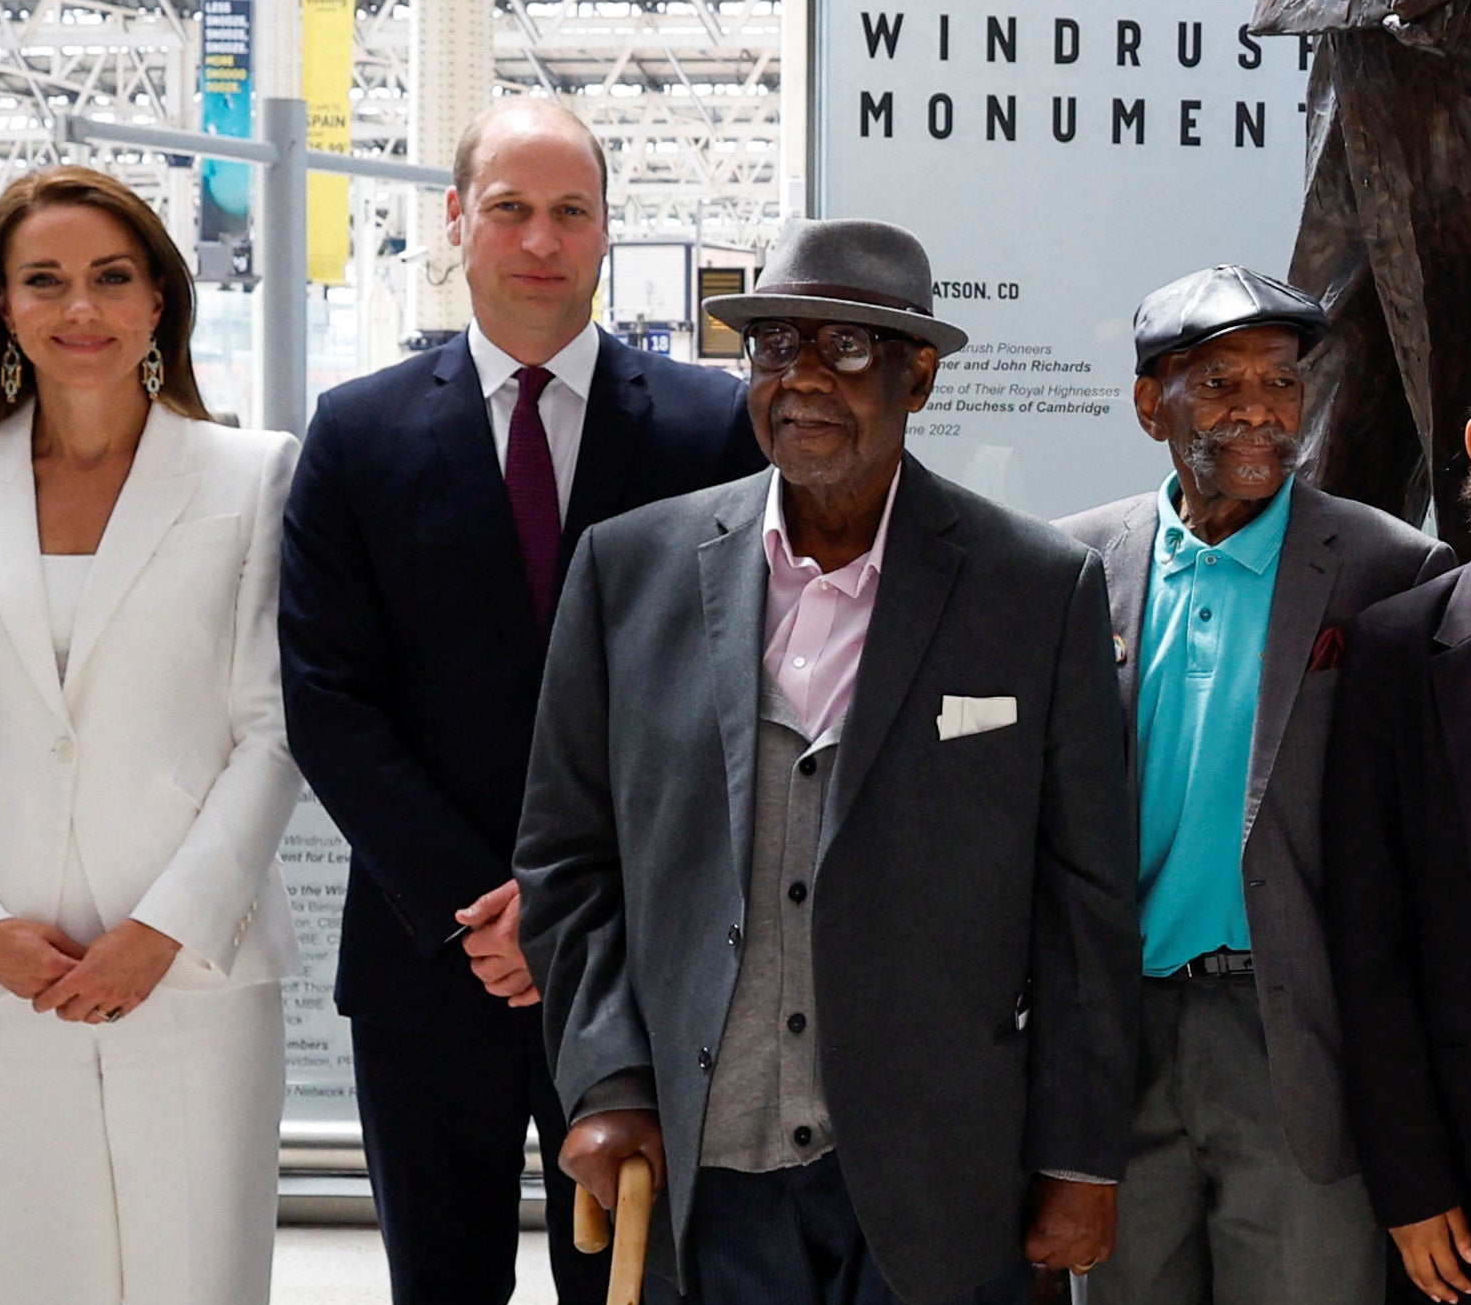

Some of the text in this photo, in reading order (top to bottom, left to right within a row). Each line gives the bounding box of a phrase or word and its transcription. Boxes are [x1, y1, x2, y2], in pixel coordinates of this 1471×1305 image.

[859, 91, 1307, 148] MONUMEN
[931, 281, 1019, 300] ATSON, CD
[996, 342, 1052, 355] Pioneers
[963, 359, 1091, 373] and John Richards
[958, 383, 1121, 399] of Their Royal Highnesses
[926, 400, 1110, 417] and Duchess of Cambridge
[904, 424, 961, 436] une 2022
